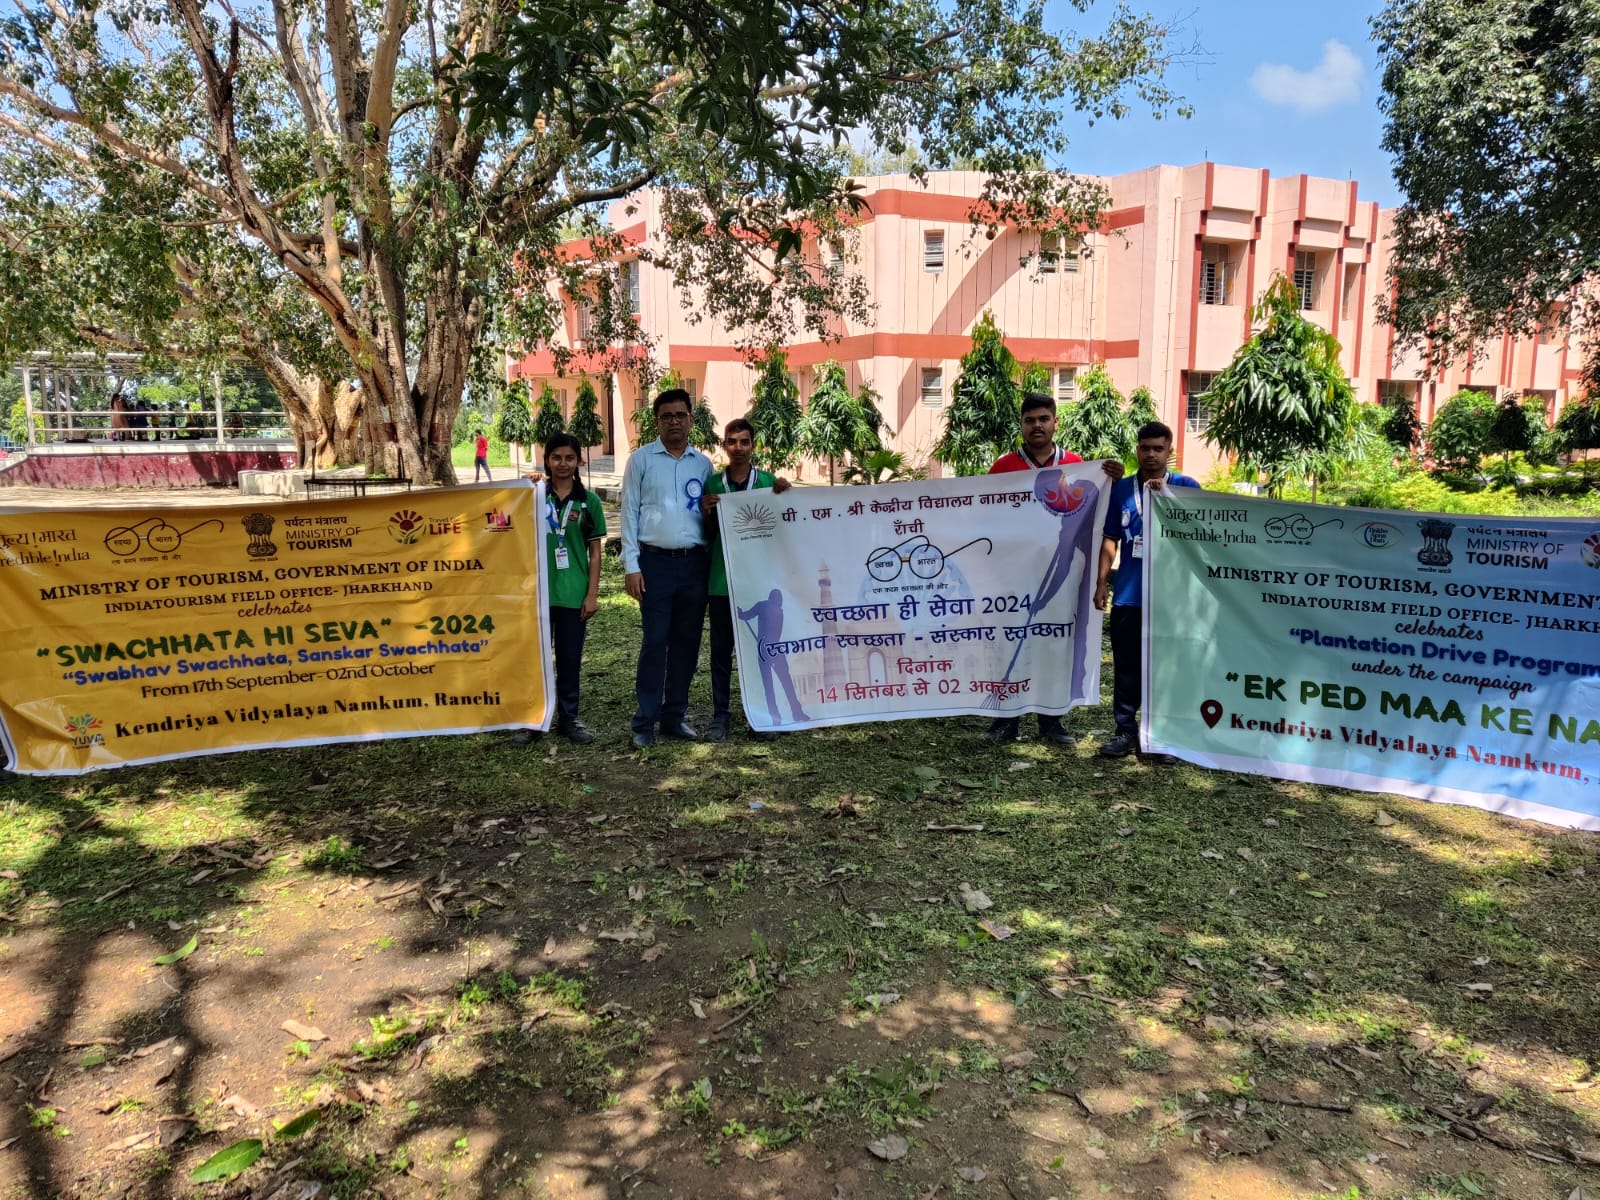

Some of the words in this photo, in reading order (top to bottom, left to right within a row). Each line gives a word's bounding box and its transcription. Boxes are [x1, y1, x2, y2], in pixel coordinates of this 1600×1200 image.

[782, 507, 798, 522] पी
[811, 507, 833, 521] एम
[847, 500, 865, 517] श्री
[870, 497, 914, 514] केन्द्रीय
[918, 495, 975, 510] विद्यालय
[284, 517, 313, 527] पर्यटन
[286, 527, 341, 540] MINISTRY
[345, 526, 361, 537] OF
[1160, 524, 1222, 543] Incredible
[287, 539, 352, 551] TOURISM
[1467, 538, 1539, 553] MINISTRY
[1543, 543, 1565, 555] OF
[1466, 551, 1549, 570] TOURISM
[40, 580, 140, 601] MINISTRY
[145, 576, 170, 591] OF
[175, 568, 270, 588] TOURISM,
[274, 561, 401, 581] GOVERNMENT
[405, 561, 428, 573] OF
[434, 558, 485, 572] INDIA
[1207, 565, 1298, 585] MINISTRY
[1304, 572, 1330, 587] OF
[1335, 573, 1438, 597] TOURISM,
[105, 593, 227, 614] INDIATOURISM
[232, 589, 275, 603] FIELD
[343, 581, 434, 597] JHARKHAND
[238, 601, 313, 618] celebrates
[810, 603, 891, 623] स्वच्छता
[897, 594, 921, 620] ही
[927, 594, 976, 617] सेवा
[982, 593, 1032, 614] 2024
[1262, 592, 1386, 613] INDIATOURISM
[1391, 602, 1442, 618] FIELD
[264, 625, 294, 646] HI
[835, 632, 907, 648] स्वच्छता
[929, 624, 997, 644] संस्कार
[1395, 619, 1484, 642] celebrates
[179, 650, 294, 674] Swachhata,
[297, 645, 373, 664] Sanskar
[897, 655, 953, 675] दिनांक
[1422, 641, 1487, 665] Drive
[141, 684, 190, 699] From
[193, 682, 223, 694] 17th
[370, 661, 437, 678] October
[817, 687, 839, 704] 14
[845, 679, 908, 701] सितंबर
[912, 677, 931, 696] से
[938, 679, 961, 695] 02
[969, 678, 1032, 701] अक्टूबर
[1351, 660, 1405, 678] under
[1408, 662, 1438, 681] the
[1443, 672, 1537, 700] campaign
[115, 713, 219, 738] Kendriya
[225, 702, 329, 722] Vidyalaya
[334, 694, 430, 715] Namkum,
[434, 691, 501, 707] Ranchi
[1300, 680, 1367, 711] PED
[1380, 690, 1466, 726] MAA
[1481, 703, 1534, 735] KE
[1548, 713, 1600, 745] NA
[1230, 713, 1334, 743] Kendriya
[1339, 725, 1458, 761] Vidyalaya
[1466, 745, 1590, 785] Namkum,
